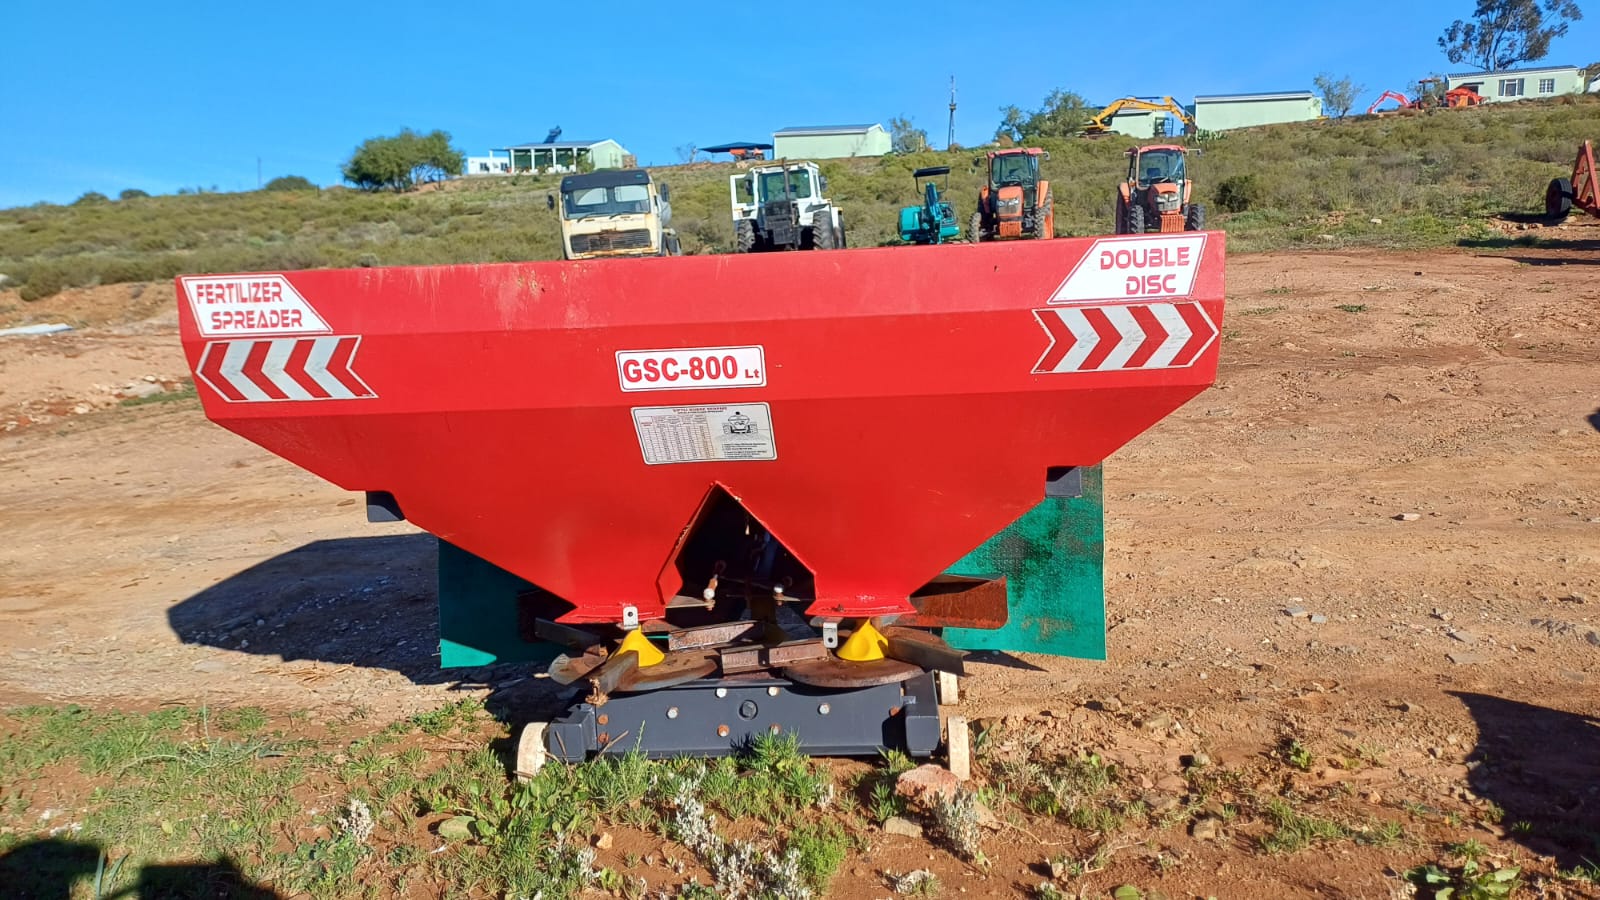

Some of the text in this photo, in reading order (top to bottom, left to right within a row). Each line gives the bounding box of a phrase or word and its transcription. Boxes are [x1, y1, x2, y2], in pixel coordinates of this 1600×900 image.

[1100, 247, 1190, 270] DOUBLE
[196, 281, 283, 304] FERTILIZER
[1126, 274, 1177, 295] DISC
[211, 309, 303, 330] SPREADER
[623, 355, 760, 383] GSC-800 Lt
